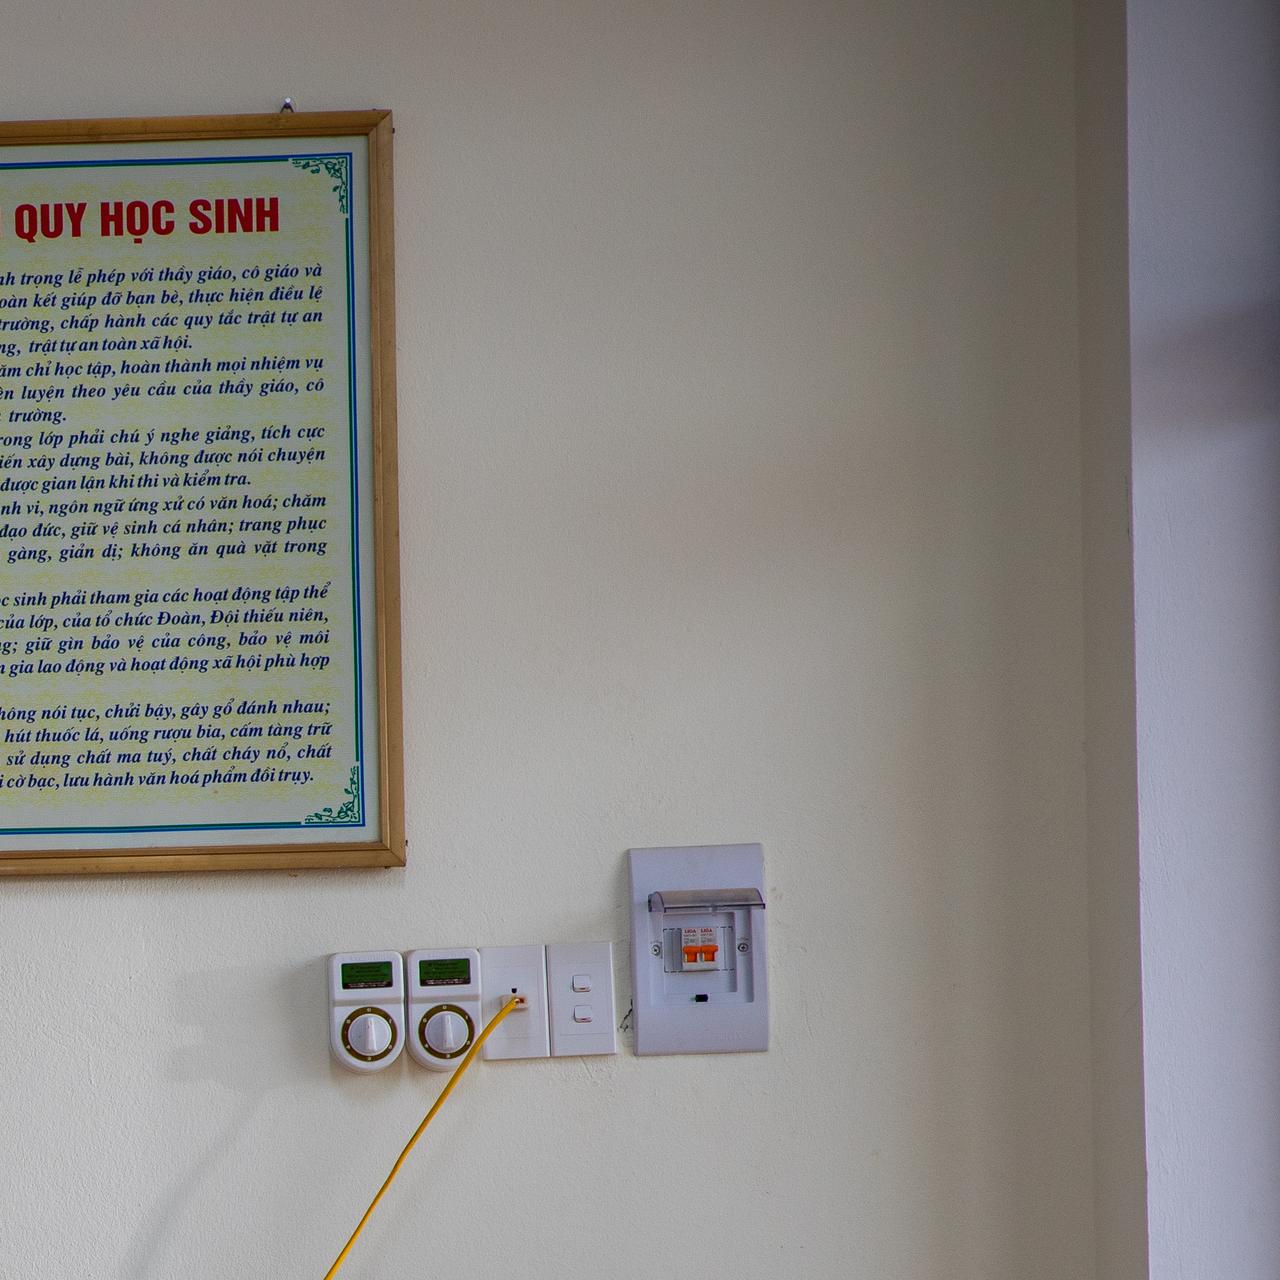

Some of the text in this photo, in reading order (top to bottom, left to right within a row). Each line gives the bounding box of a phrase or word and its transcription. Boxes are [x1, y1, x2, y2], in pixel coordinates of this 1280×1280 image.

[16, 203, 86, 242] QUY
[101, 200, 174, 244] HỌC
[189, 198, 278, 234] SINH
[20, 272, 64, 289] trọng
[85, 268, 126, 288] phép
[130, 267, 155, 283] với
[158, 264, 193, 285] thầy
[196, 265, 237, 285] giáo,
[241, 265, 260, 280] cô
[263, 263, 300, 283] giáo
[304, 262, 322, 277] và
[25, 359, 52, 377] chỉ
[53, 361, 84, 380] học
[86, 361, 116, 379] tập,
[120, 359, 161, 375] hoàn
[164, 357, 212, 374] thành
[215, 356, 247, 375] mọi
[250, 355, 301, 374] nhiệm
[305, 358, 324, 372] vụ
[21, 385, 65, 403] luyện
[71, 383, 107, 399] theo
[111, 383, 141, 401] yêu
[147, 379, 177, 397] cầu
[182, 379, 213, 396] của
[218, 377, 254, 398] thầy
[258, 378, 299, 397] giáo,
[305, 377, 325, 392] cô
[38, 430, 64, 449] lớp
[67, 428, 105, 449] phải
[109, 428, 140, 444] chú
[143, 428, 156, 447] ý
[160, 427, 200, 446] nghe
[204, 424, 256, 445] giảng,
[261, 424, 291, 440] tích
[297, 426, 326, 442] cực
[32, 522, 66, 540] đức,
[102, 521, 119, 539] vệ
[123, 519, 158, 535] sinh
[162, 519, 181, 534] cá
[185, 518, 234, 535] nhân;
[238, 519, 283, 535] trang
[285, 515, 327, 535] phục
[6, 546, 52, 565] gàng,
[58, 542, 95, 563] giản
[101, 543, 124, 562] dị;
[130, 542, 182, 561] không
[187, 542, 209, 556] ăn
[215, 540, 247, 559] quà
[254, 540, 278, 558] vặt
[283, 540, 328, 557] trong
[57, 636, 84, 655] gìn
[91, 633, 121, 650] bảo
[127, 634, 145, 653] vệ
[151, 631, 181, 649] của
[187, 633, 231, 651] công,
[238, 629, 268, 646] bảo
[275, 630, 292, 649] vệ
[298, 629, 330, 645] môi
[40, 704, 68, 720] nói
[70, 706, 101, 723] tục,
[144, 703, 177, 721] bậy,
[179, 702, 209, 721] gây
[236, 699, 278, 716] đánh
[282, 699, 331, 716] nhau;
[6, 749, 27, 766] sử
[29, 750, 72, 769] dụng
[76, 748, 112, 765] chất
[116, 752, 142, 764] ma
[182, 745, 218, 762] chất
[222, 745, 261, 764] cháy
[296, 742, 333, 759] chất
